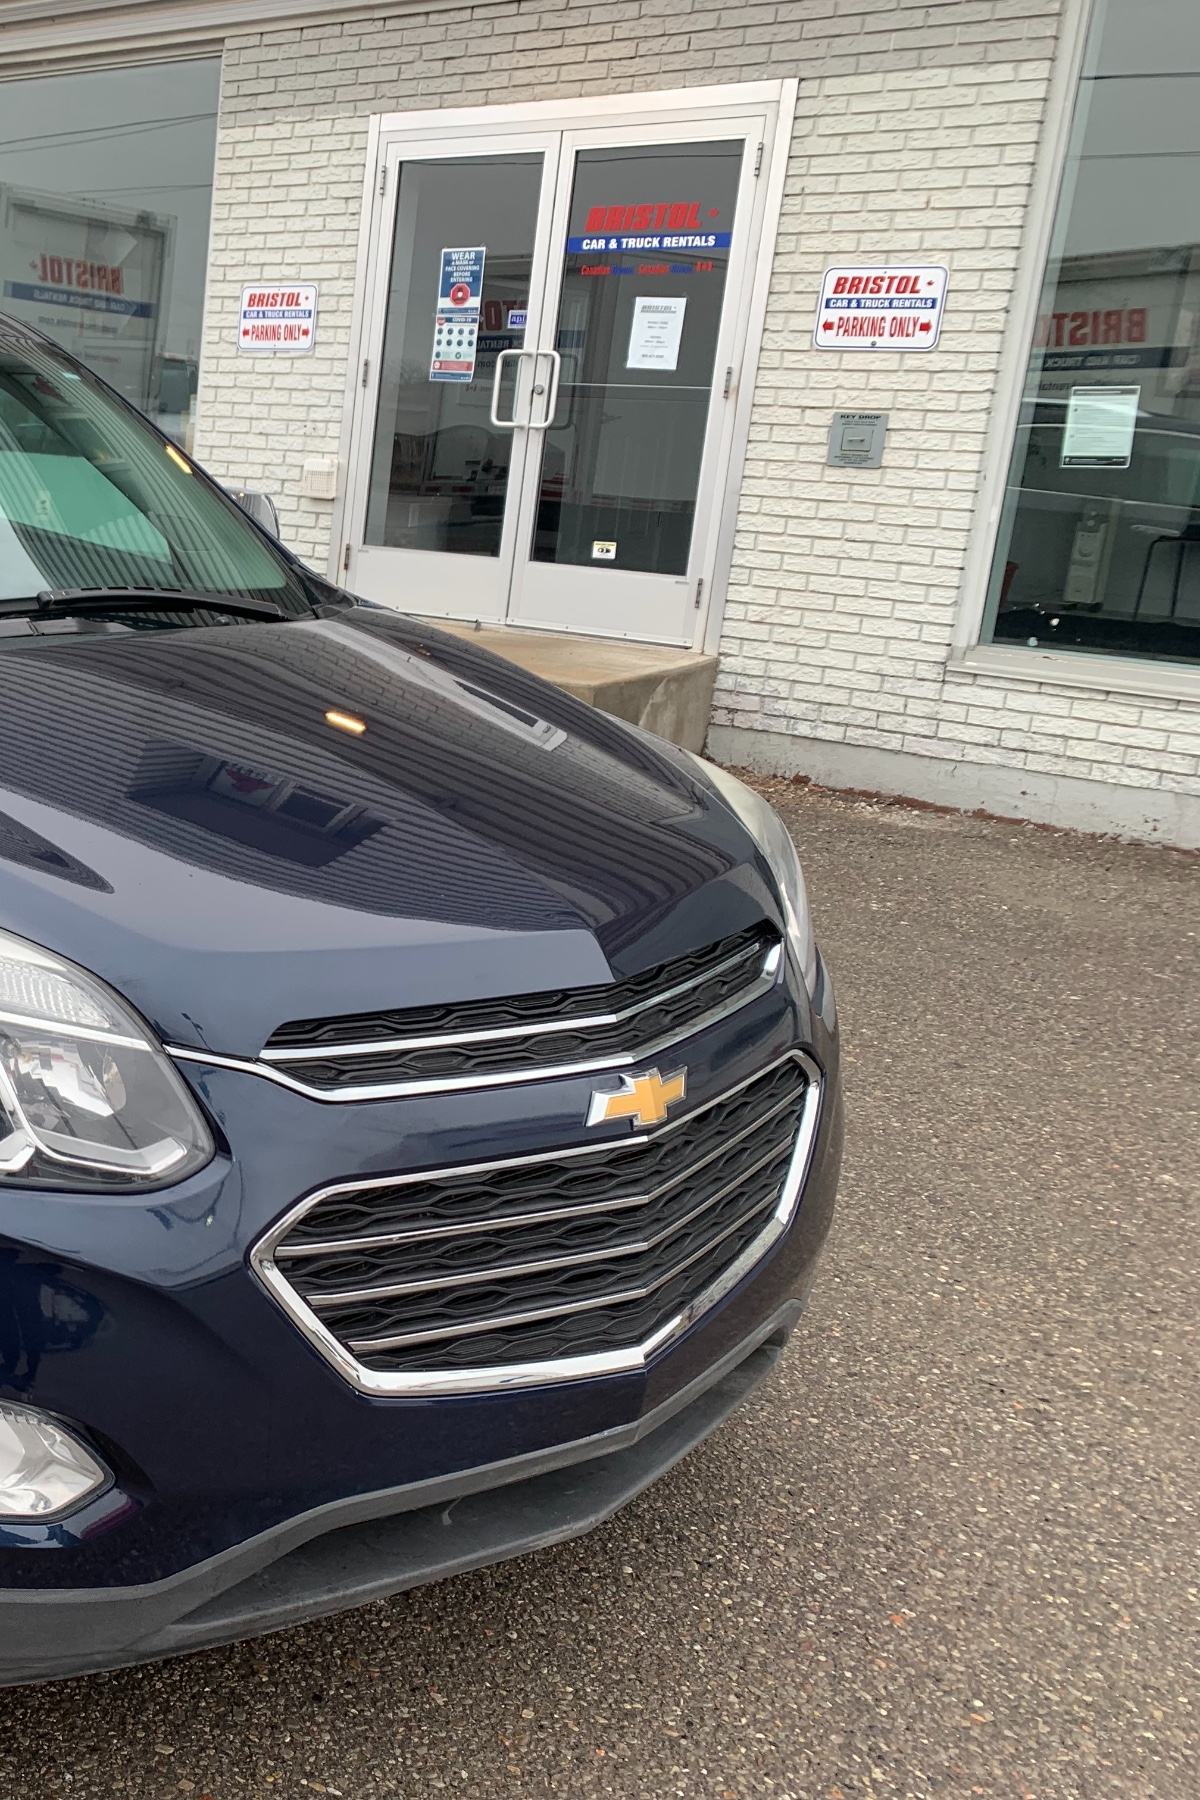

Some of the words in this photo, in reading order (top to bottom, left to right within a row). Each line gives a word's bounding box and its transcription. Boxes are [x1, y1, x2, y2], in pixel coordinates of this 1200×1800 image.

[585, 201, 702, 232] BRISTOL
[582, 238, 606, 250] CAR
[608, 238, 618, 249] &
[621, 236, 660, 249] TRUCK
[663, 235, 716, 247] RENTALS
[451, 251, 476, 260] WEAR
[832, 275, 921, 294] BRISTOL
[247, 292, 302, 308] BRISTOL
[830, 299, 848, 308] CAR
[851, 299, 857, 307] &
[861, 299, 892, 308] TRUCK
[893, 299, 933, 308] RENTALS
[284, 310, 309, 318] RENTALS
[251, 324, 281, 341] PARKING
[284, 324, 302, 341] ONLY
[836, 316, 886, 337] PARKING
[889, 316, 920, 338] ONLY
